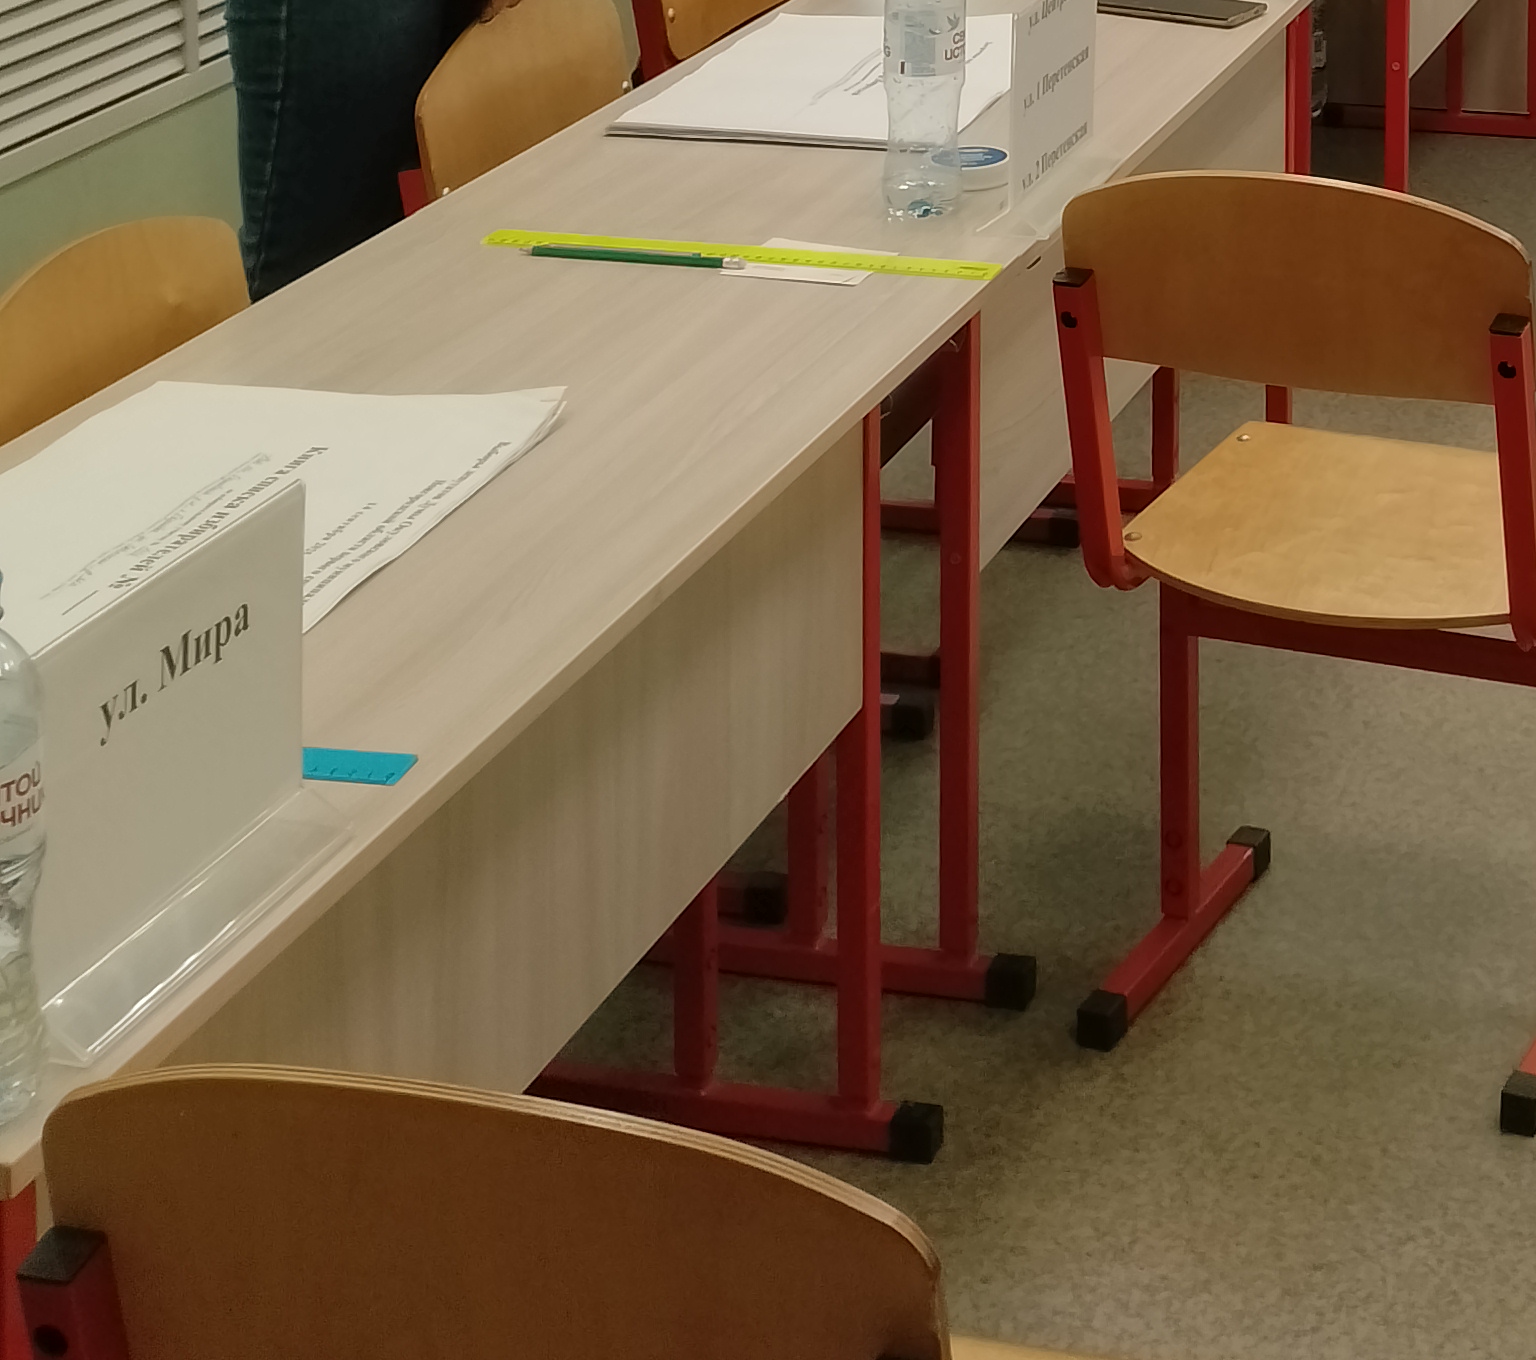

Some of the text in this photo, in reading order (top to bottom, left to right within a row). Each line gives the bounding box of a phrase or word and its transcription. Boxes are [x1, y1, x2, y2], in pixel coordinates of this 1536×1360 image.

[274, 446, 330, 477] Книга
[224, 476, 280, 510] списка
[129, 511, 230, 573] избирателей
[100, 603, 250, 747] ул. Мира
